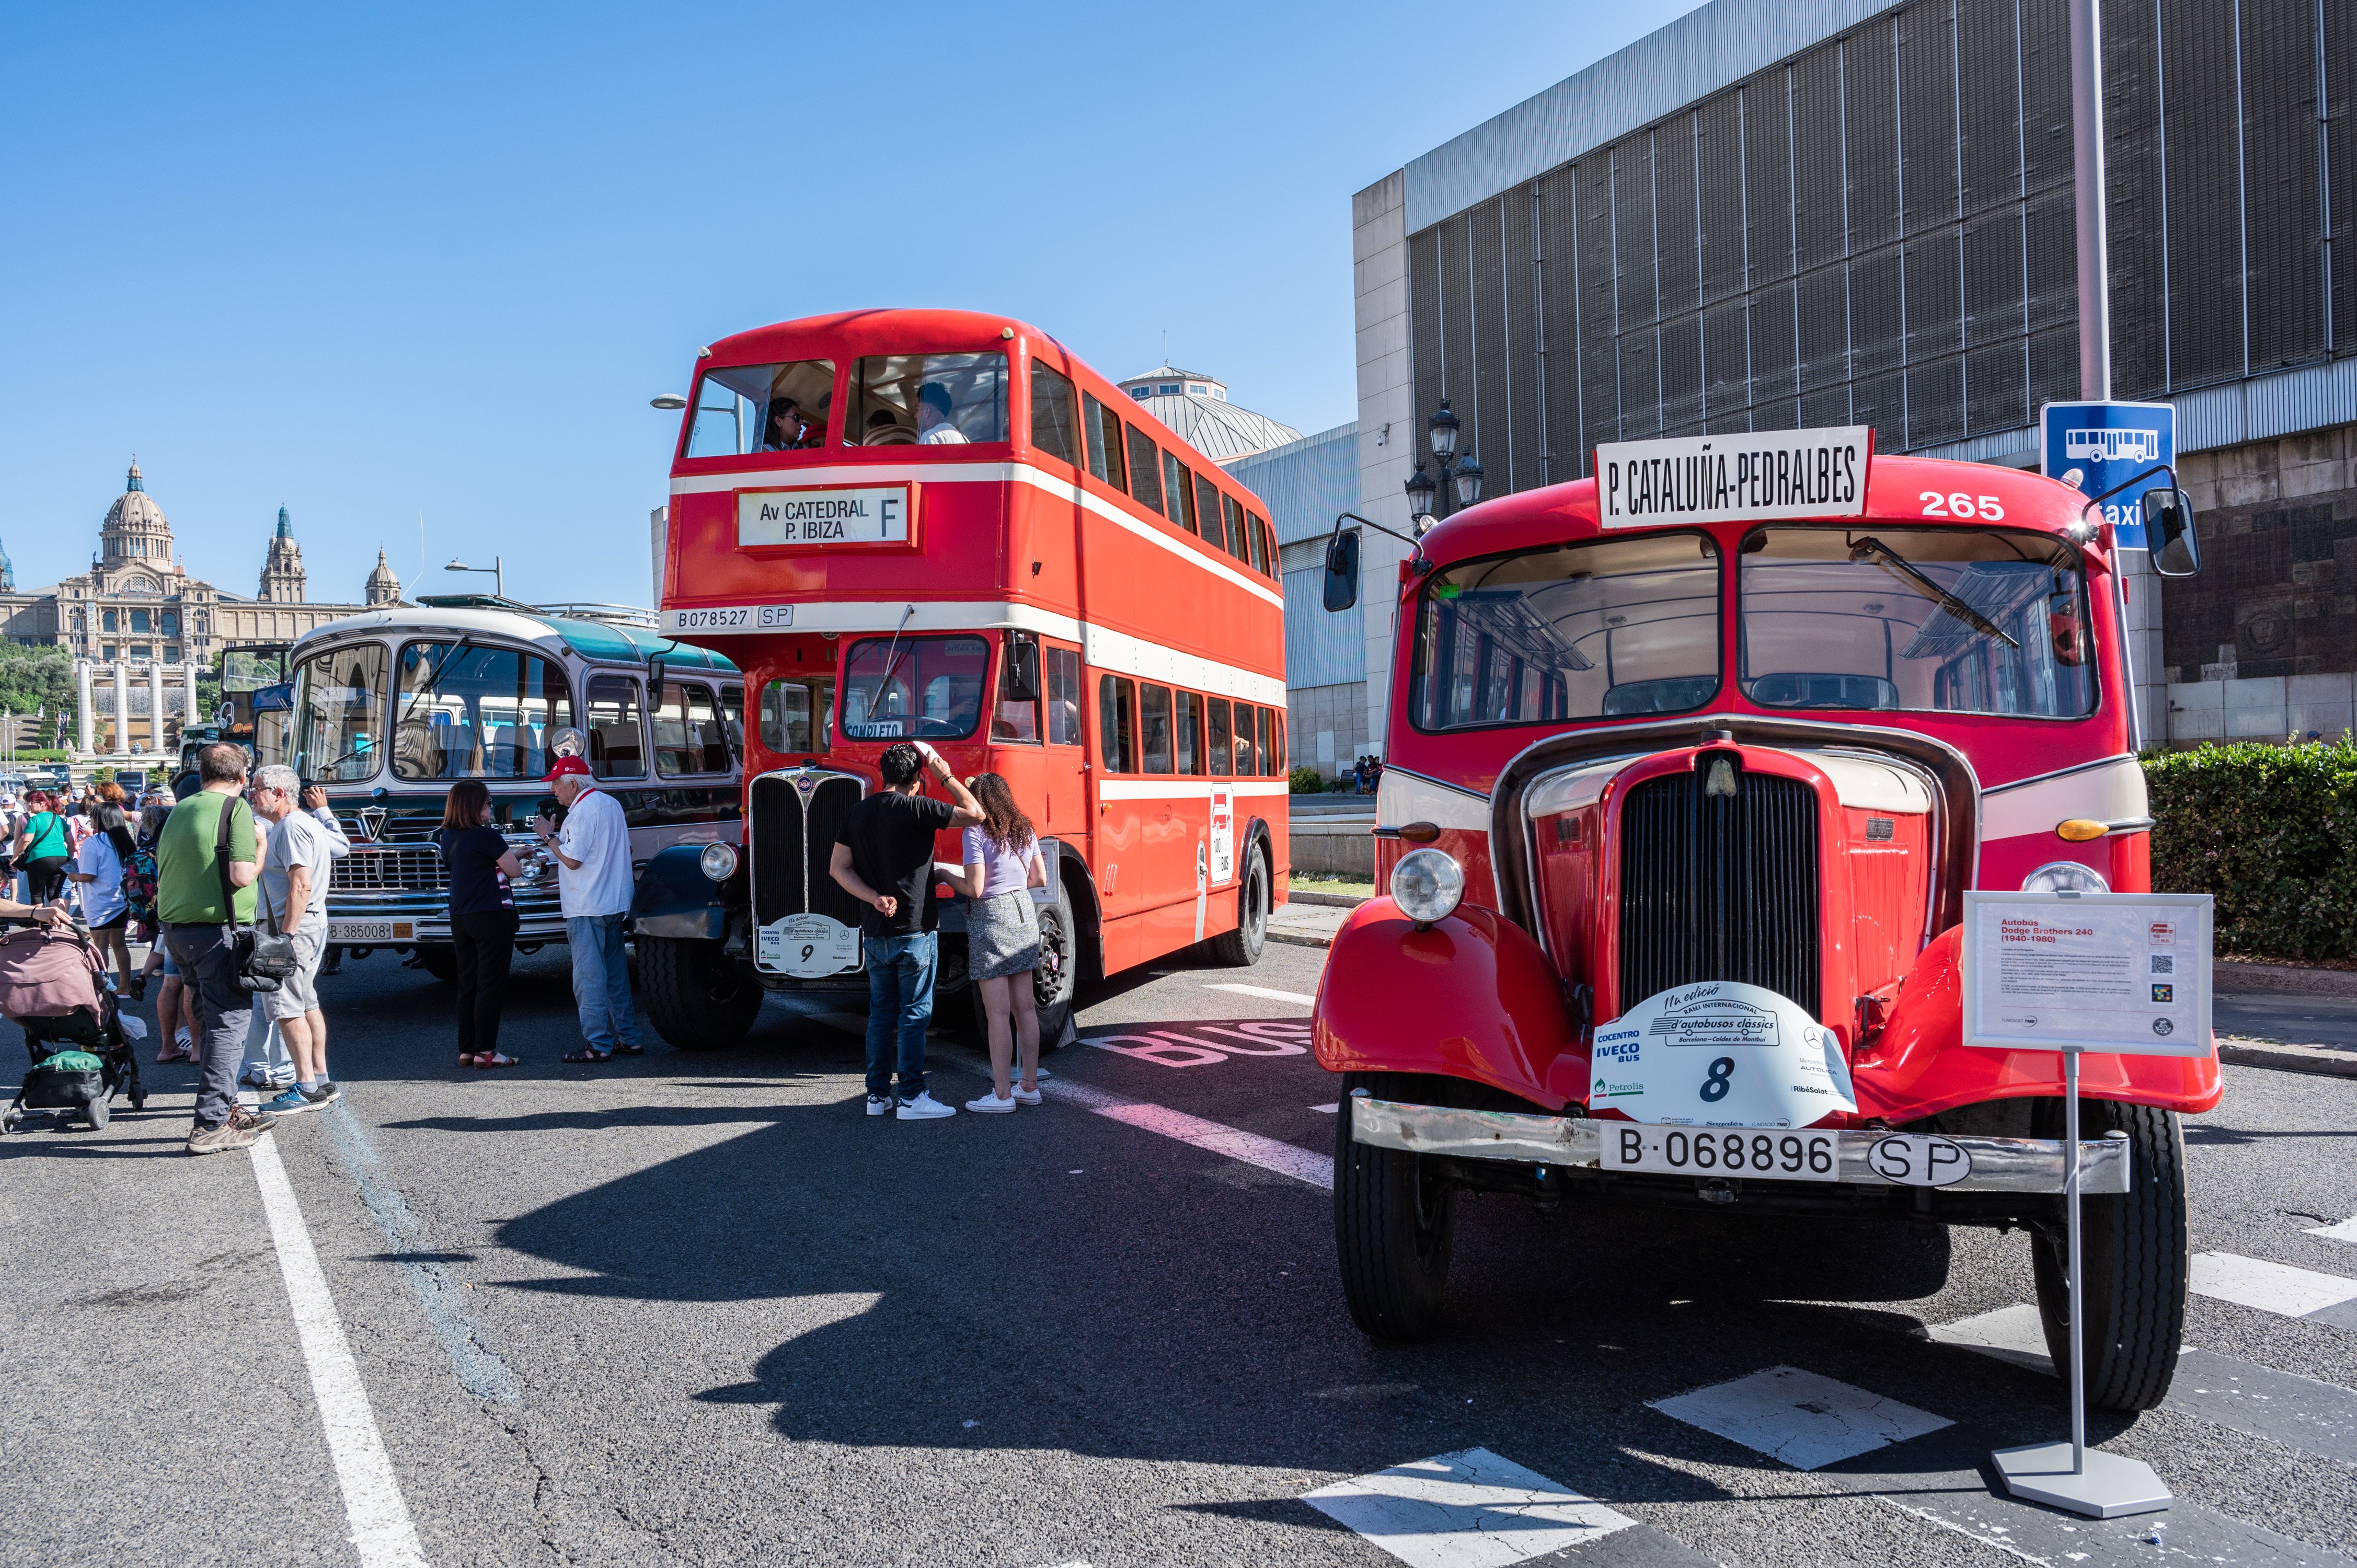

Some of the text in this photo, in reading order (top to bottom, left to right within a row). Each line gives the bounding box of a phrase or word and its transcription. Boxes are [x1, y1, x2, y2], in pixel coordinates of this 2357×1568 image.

[1608, 443, 1855, 515] P. CATALUÑA-PEDRALBES
[760, 500, 869, 521] Av CATEDRAL
[1919, 491, 2005, 521] 265
[2099, 499, 2140, 526] axi
[881, 499, 898, 537] F
[786, 521, 844, 539] P. IBIZA
[763, 608, 788, 624] SP
[2001, 935, 2055, 944] (1940-1980)
[801, 944, 814, 962] 9
[1684, 983, 1721, 1001] edició
[1703, 1002, 1757, 1014] INTERNACIONAL
[1671, 1019, 1774, 1029] d'autobusos clàssics
[1598, 1030, 1640, 1043] COCENTRO
[1596, 1043, 1640, 1057] IVECO
[1618, 1054, 1640, 1063] BUS
[1801, 1066, 1837, 1075] AUTOLICA
[1609, 1082, 1643, 1091] Petrolis
[1699, 1056, 1735, 1103] 8
[1793, 1086, 1828, 1094] RibéSalat
[1879, 1139, 1960, 1181] SP
